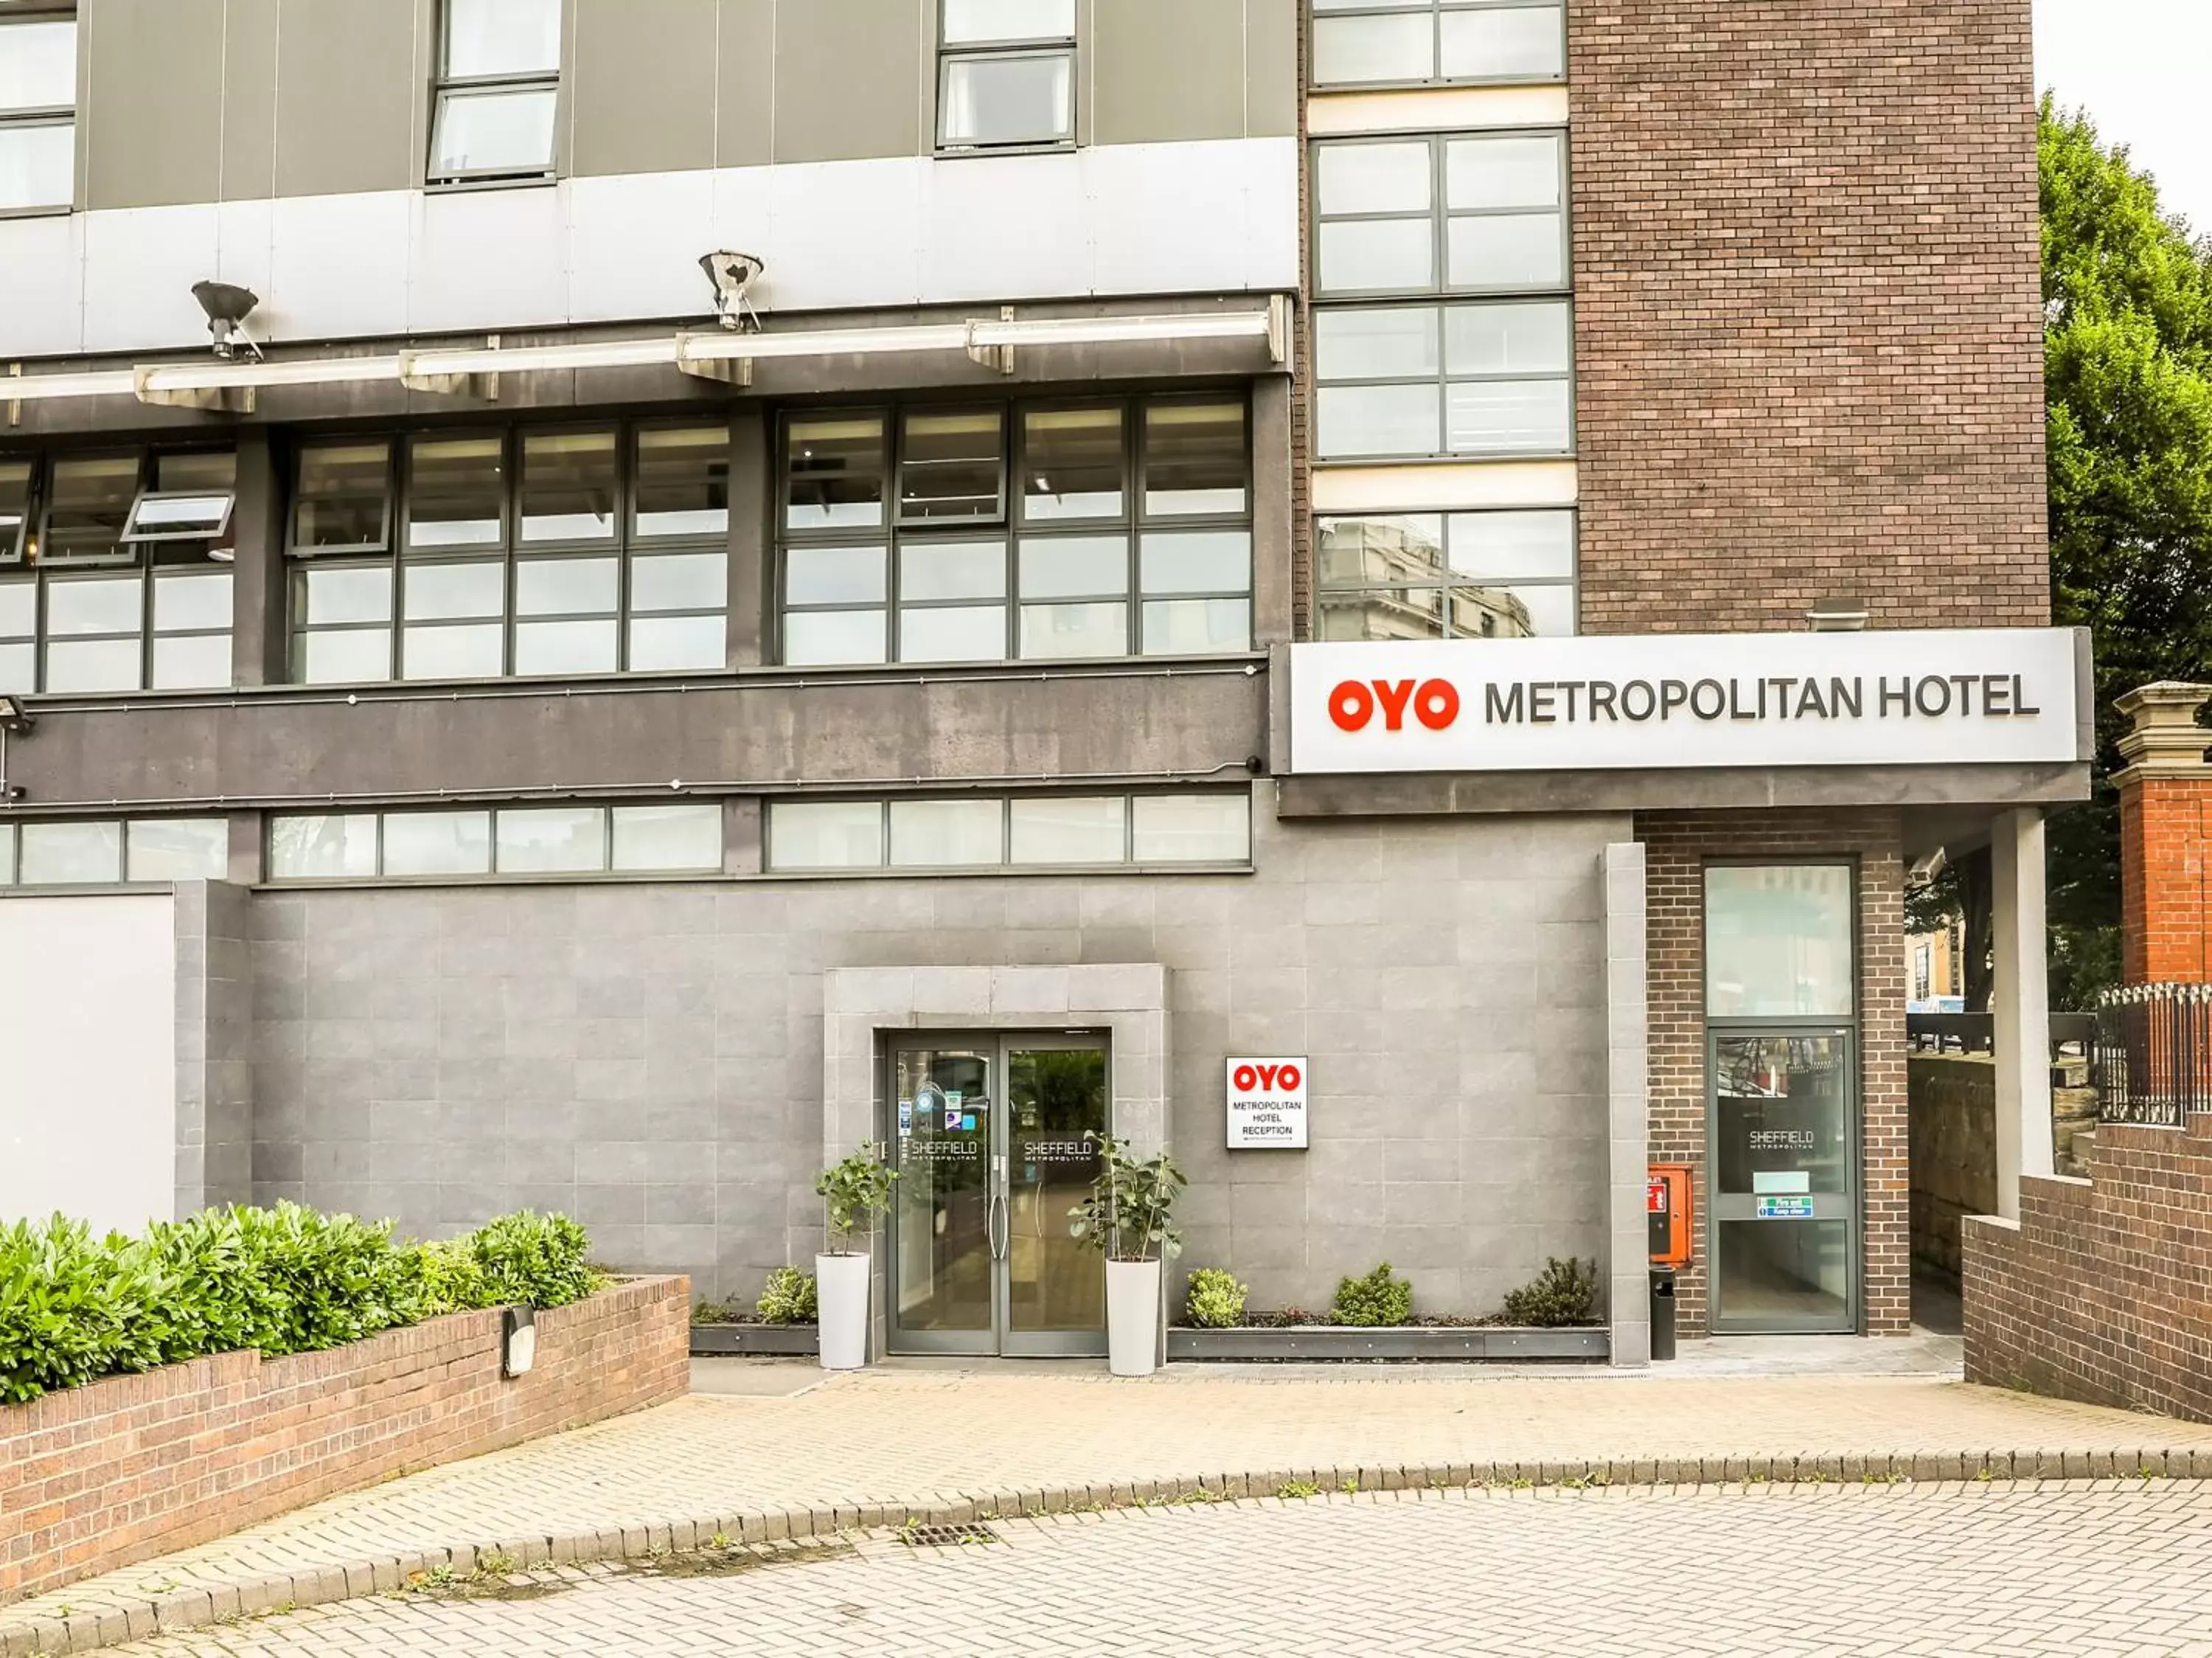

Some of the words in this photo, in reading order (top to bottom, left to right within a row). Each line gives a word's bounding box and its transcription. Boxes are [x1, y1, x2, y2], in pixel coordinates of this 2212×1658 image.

[1328, 678, 1460, 732] OYO
[1485, 676, 1863, 724] METROPOLITAN
[1879, 673, 2041, 718] HOTEL
[1234, 1064, 1301, 1092] OYO
[1233, 1101, 1301, 1110] METROPOLITAN
[1253, 1114, 1281, 1123] HOTEL
[1242, 1126, 1293, 1135] RECEPTION
[1750, 1131, 1814, 1143] SHEFFIELD
[912, 1141, 977, 1154] SHEFFIELD
[1024, 1142, 1092, 1155] SHEFFIELD
